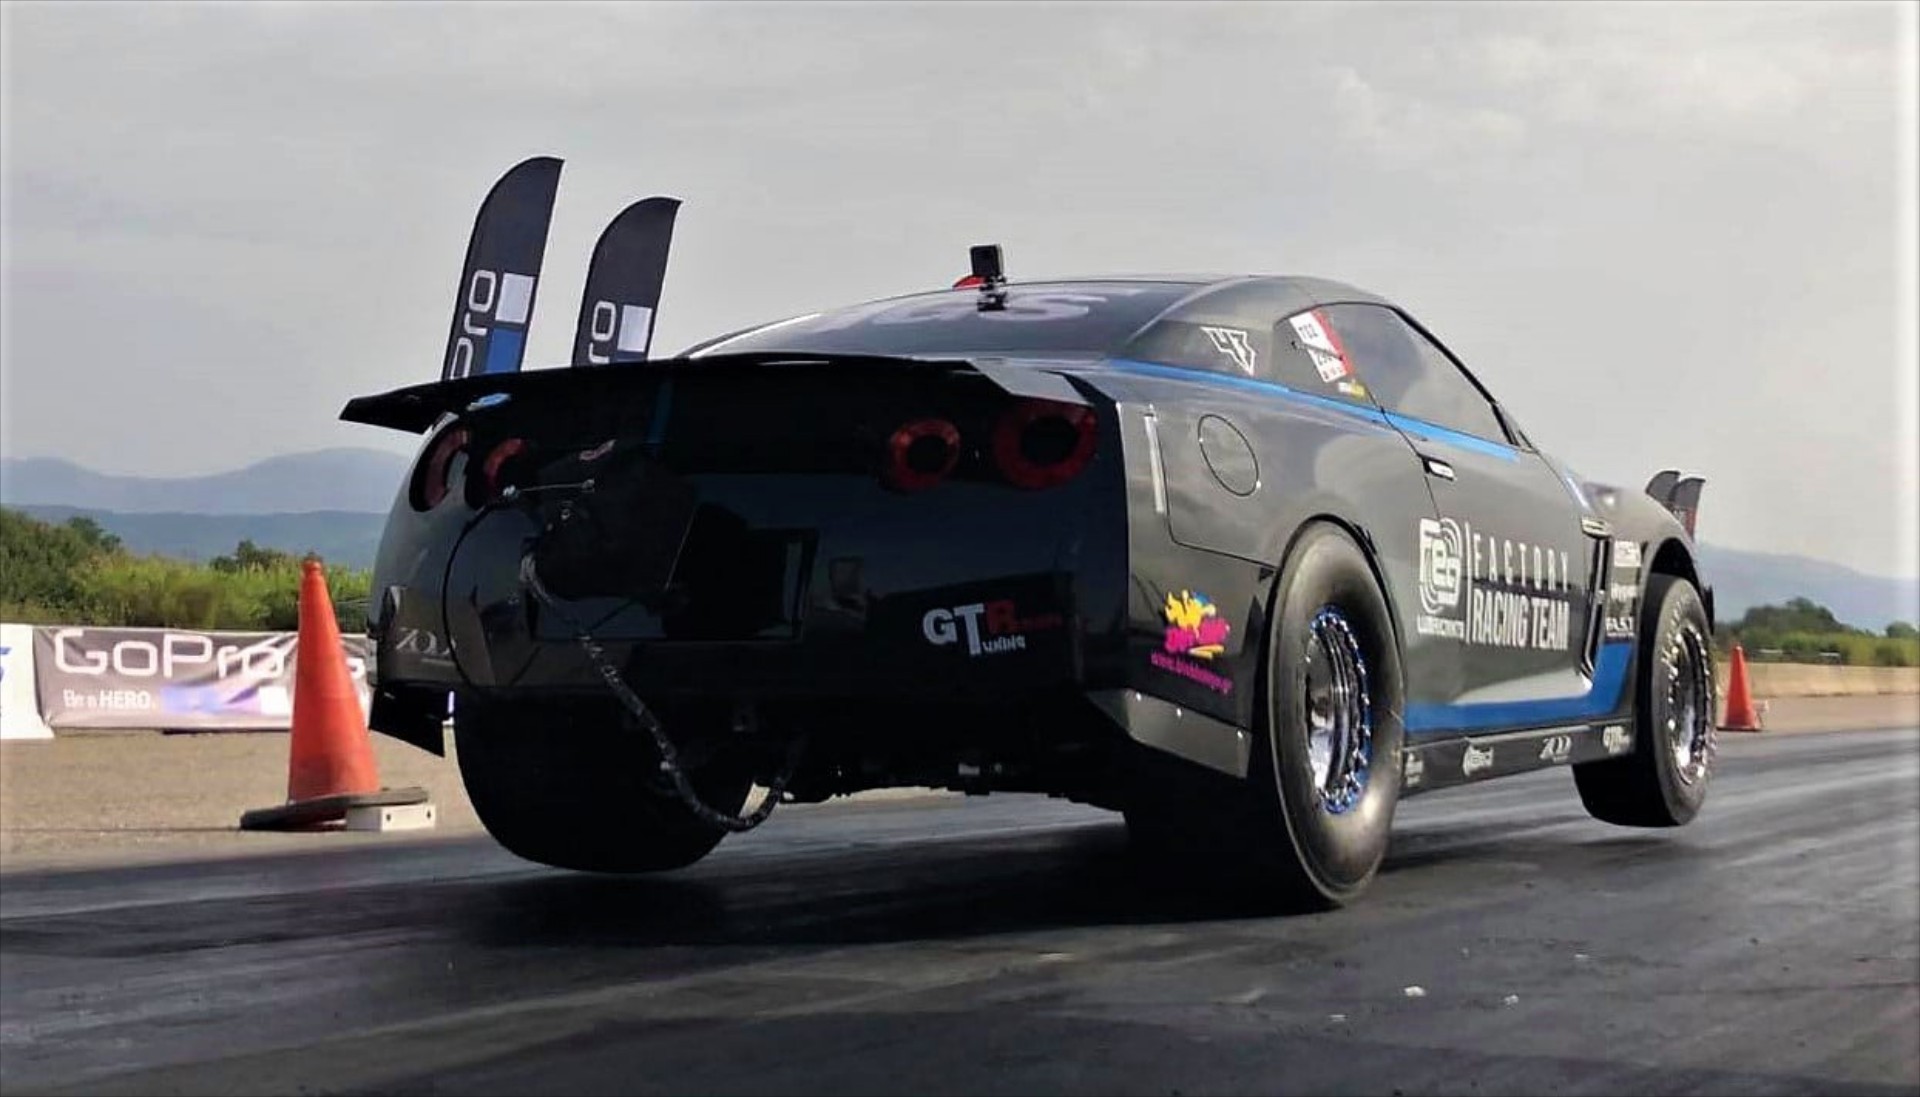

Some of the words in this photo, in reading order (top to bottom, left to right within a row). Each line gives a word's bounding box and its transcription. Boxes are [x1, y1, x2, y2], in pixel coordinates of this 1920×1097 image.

[1473, 532, 1569, 593] FACTORY
[1472, 588, 1530, 648] RACING
[1531, 597, 1570, 651] TEAM
[54, 628, 286, 680] GoPro
